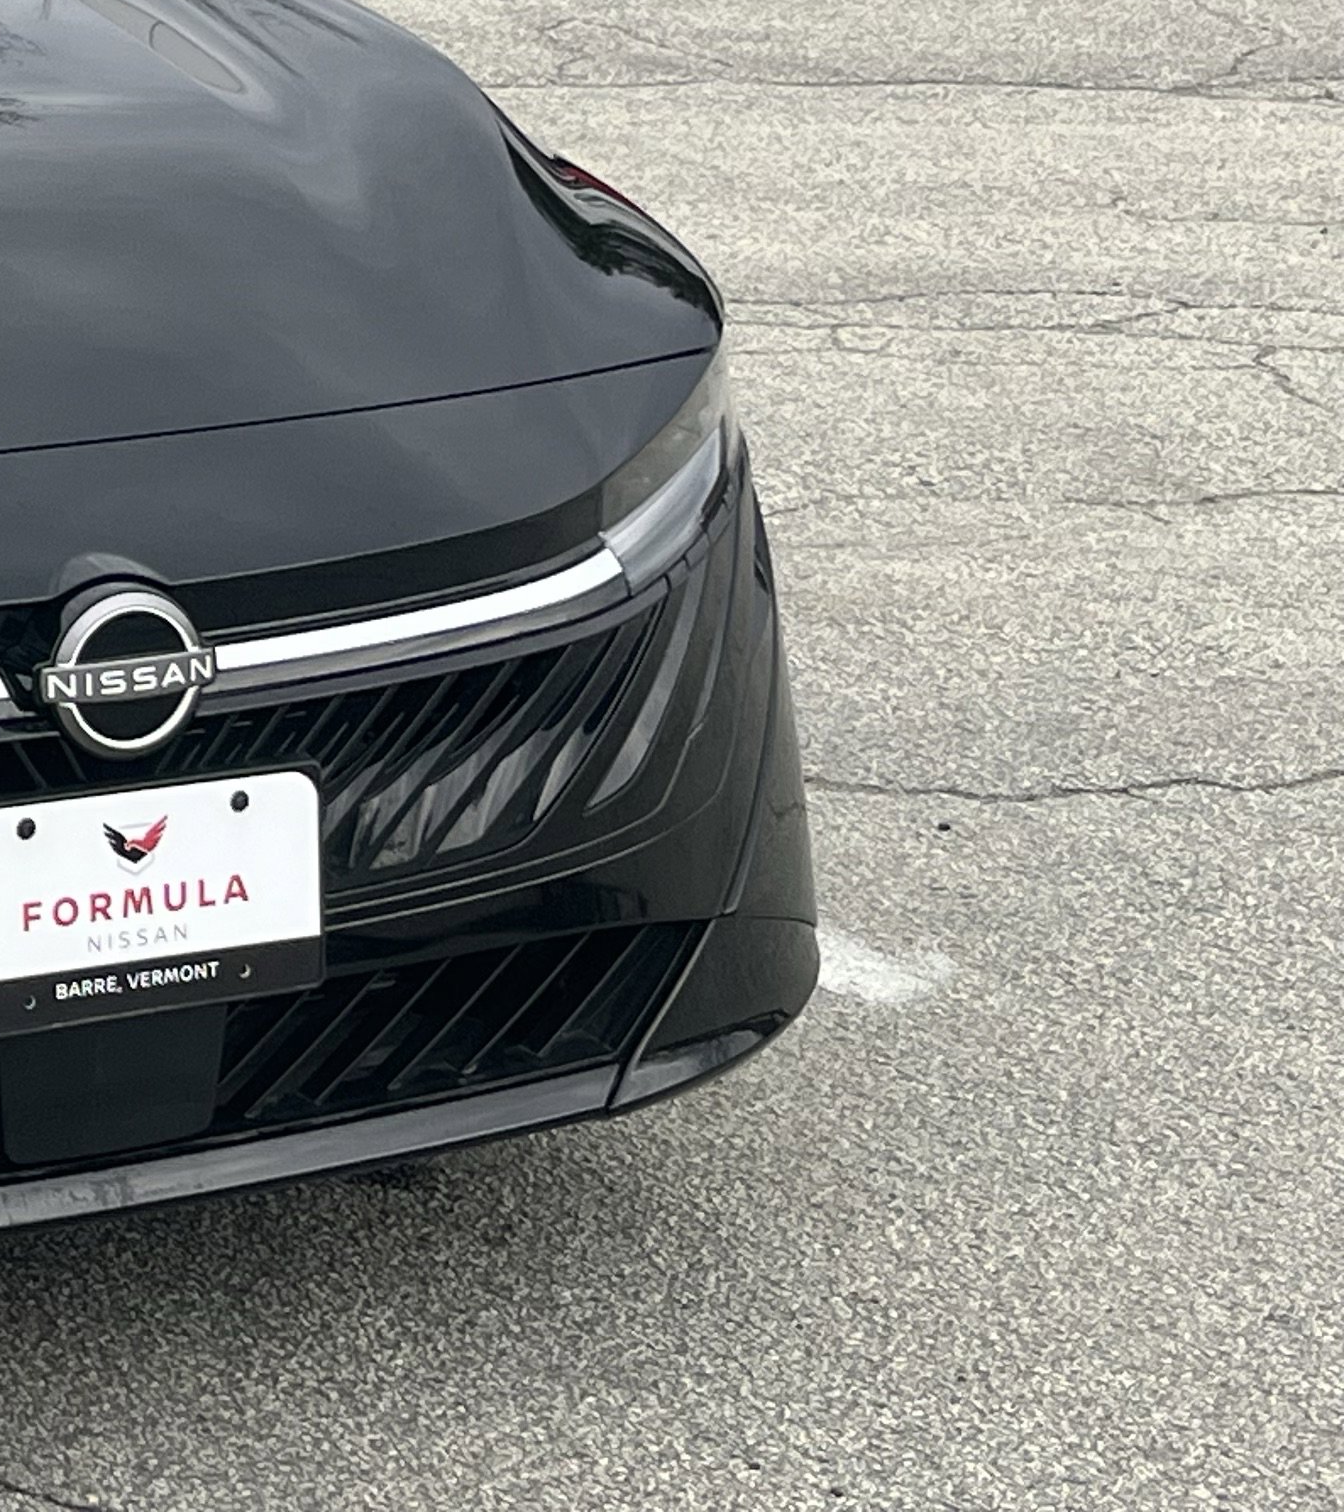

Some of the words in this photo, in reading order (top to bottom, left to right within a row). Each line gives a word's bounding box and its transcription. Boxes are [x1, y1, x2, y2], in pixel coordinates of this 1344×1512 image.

[45, 654, 213, 700] NISSAN
[21, 873, 251, 933] FORMULA
[86, 923, 190, 954] NISSAN
[126, 961, 221, 991] VERMONT
